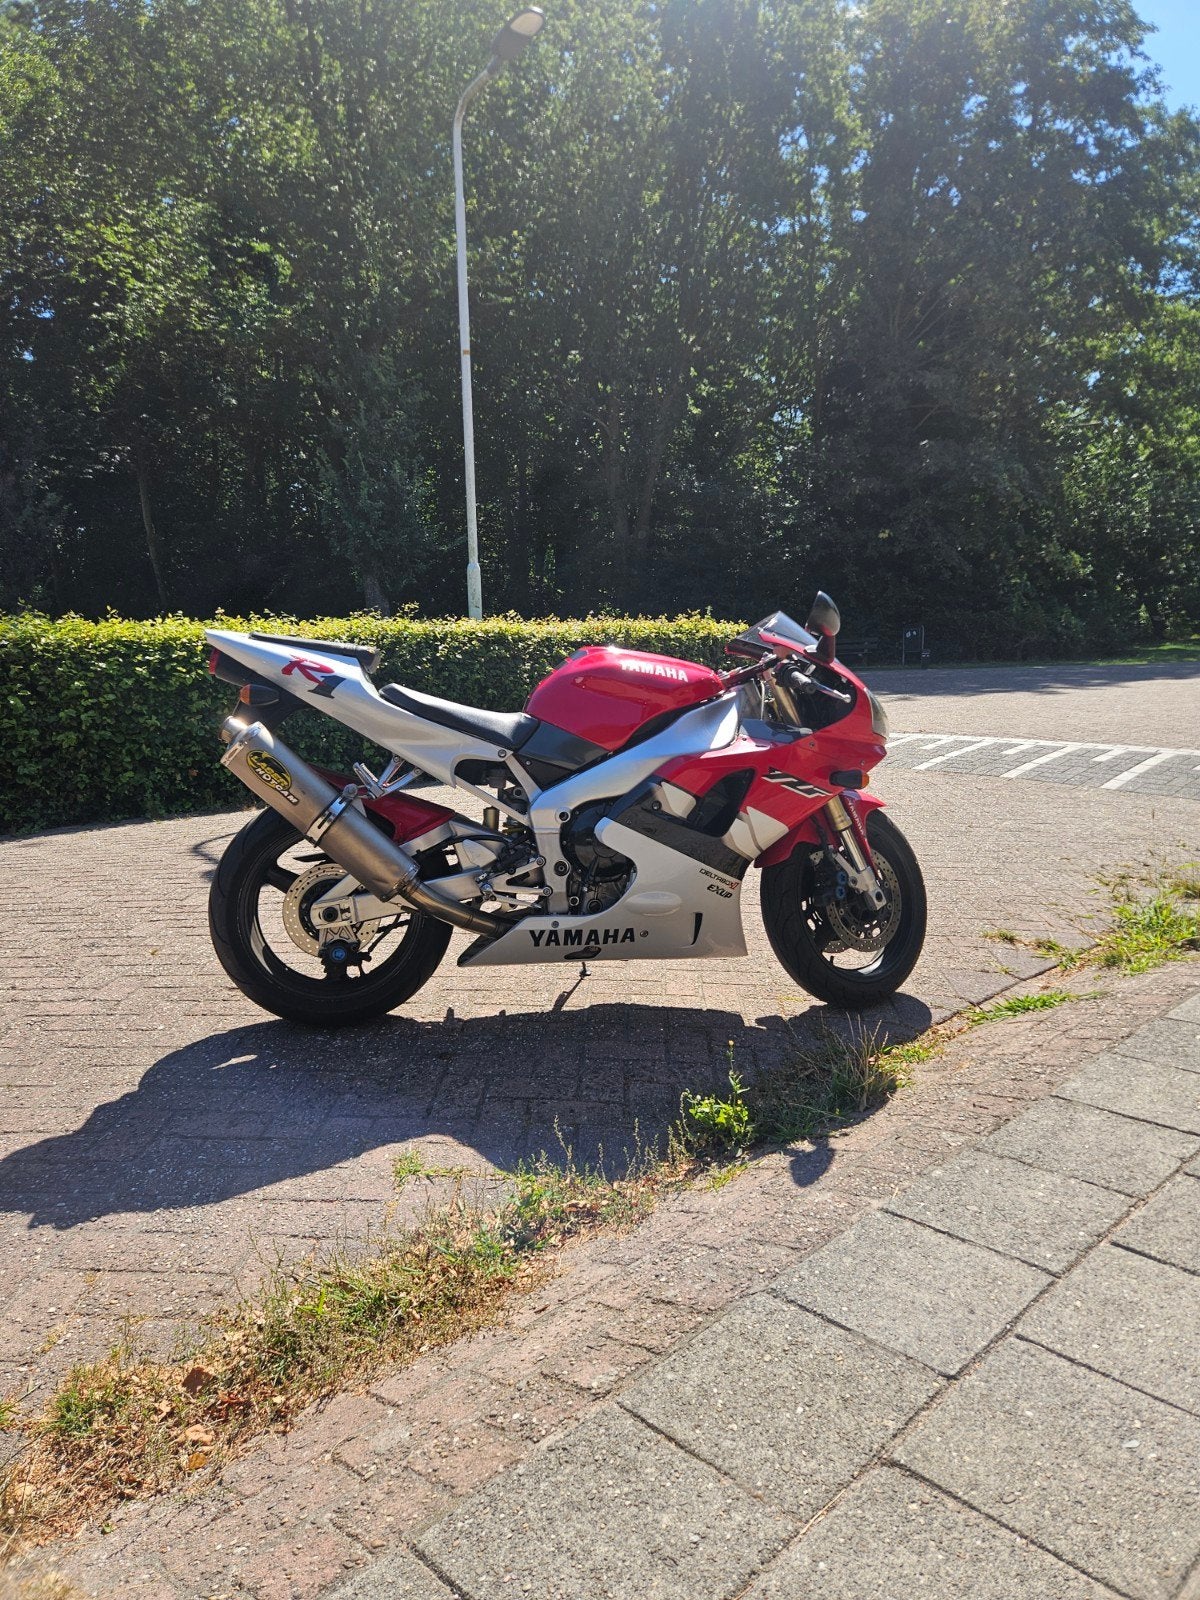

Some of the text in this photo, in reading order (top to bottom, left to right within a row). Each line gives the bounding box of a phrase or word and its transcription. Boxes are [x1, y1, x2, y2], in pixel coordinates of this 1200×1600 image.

[620, 659, 689, 683] YAMAHA
[707, 884, 733, 899] EXUP
[528, 927, 636, 948] YAMAHA
